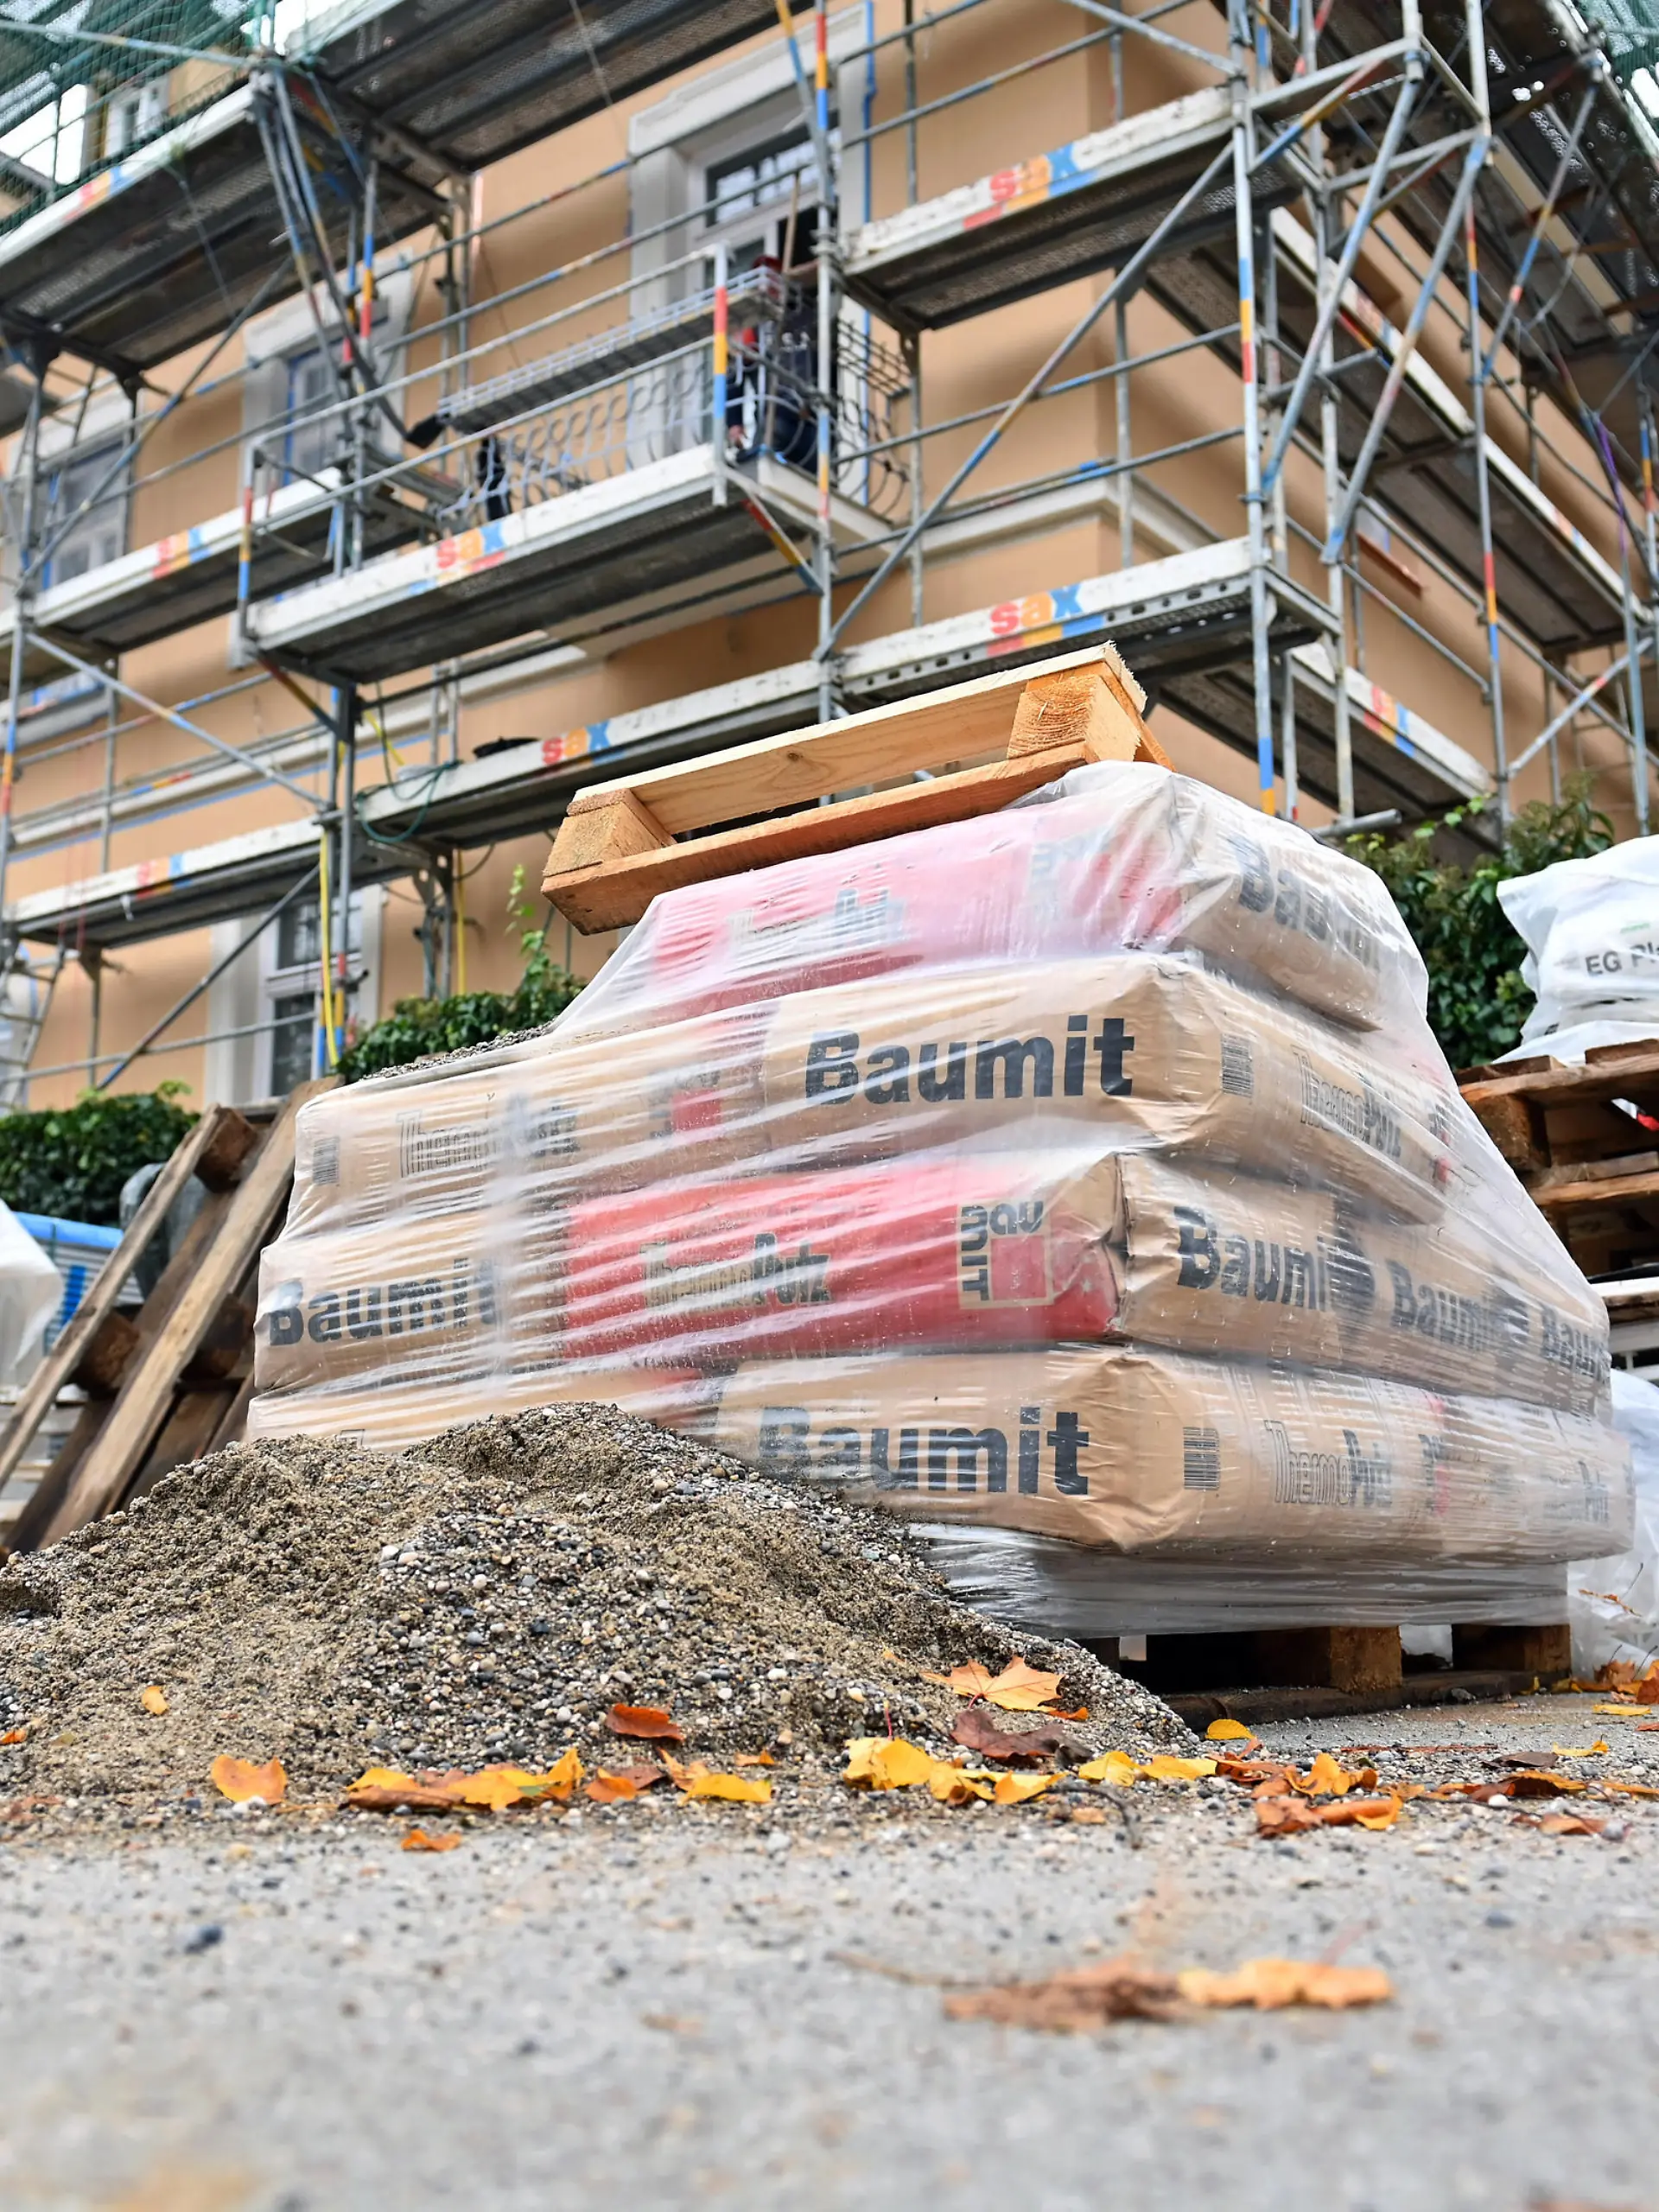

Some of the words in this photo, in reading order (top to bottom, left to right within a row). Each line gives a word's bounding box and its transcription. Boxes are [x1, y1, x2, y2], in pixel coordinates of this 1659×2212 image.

[989, 142, 1080, 202] sax
[989, 582, 1083, 634] sax
[541, 719, 611, 765] sax
[1585, 950, 1623, 977] EG
[804, 1014, 1135, 1105] Baumit
[269, 1258, 499, 1346] Baumit
[757, 1406, 1090, 1496] Baumit
